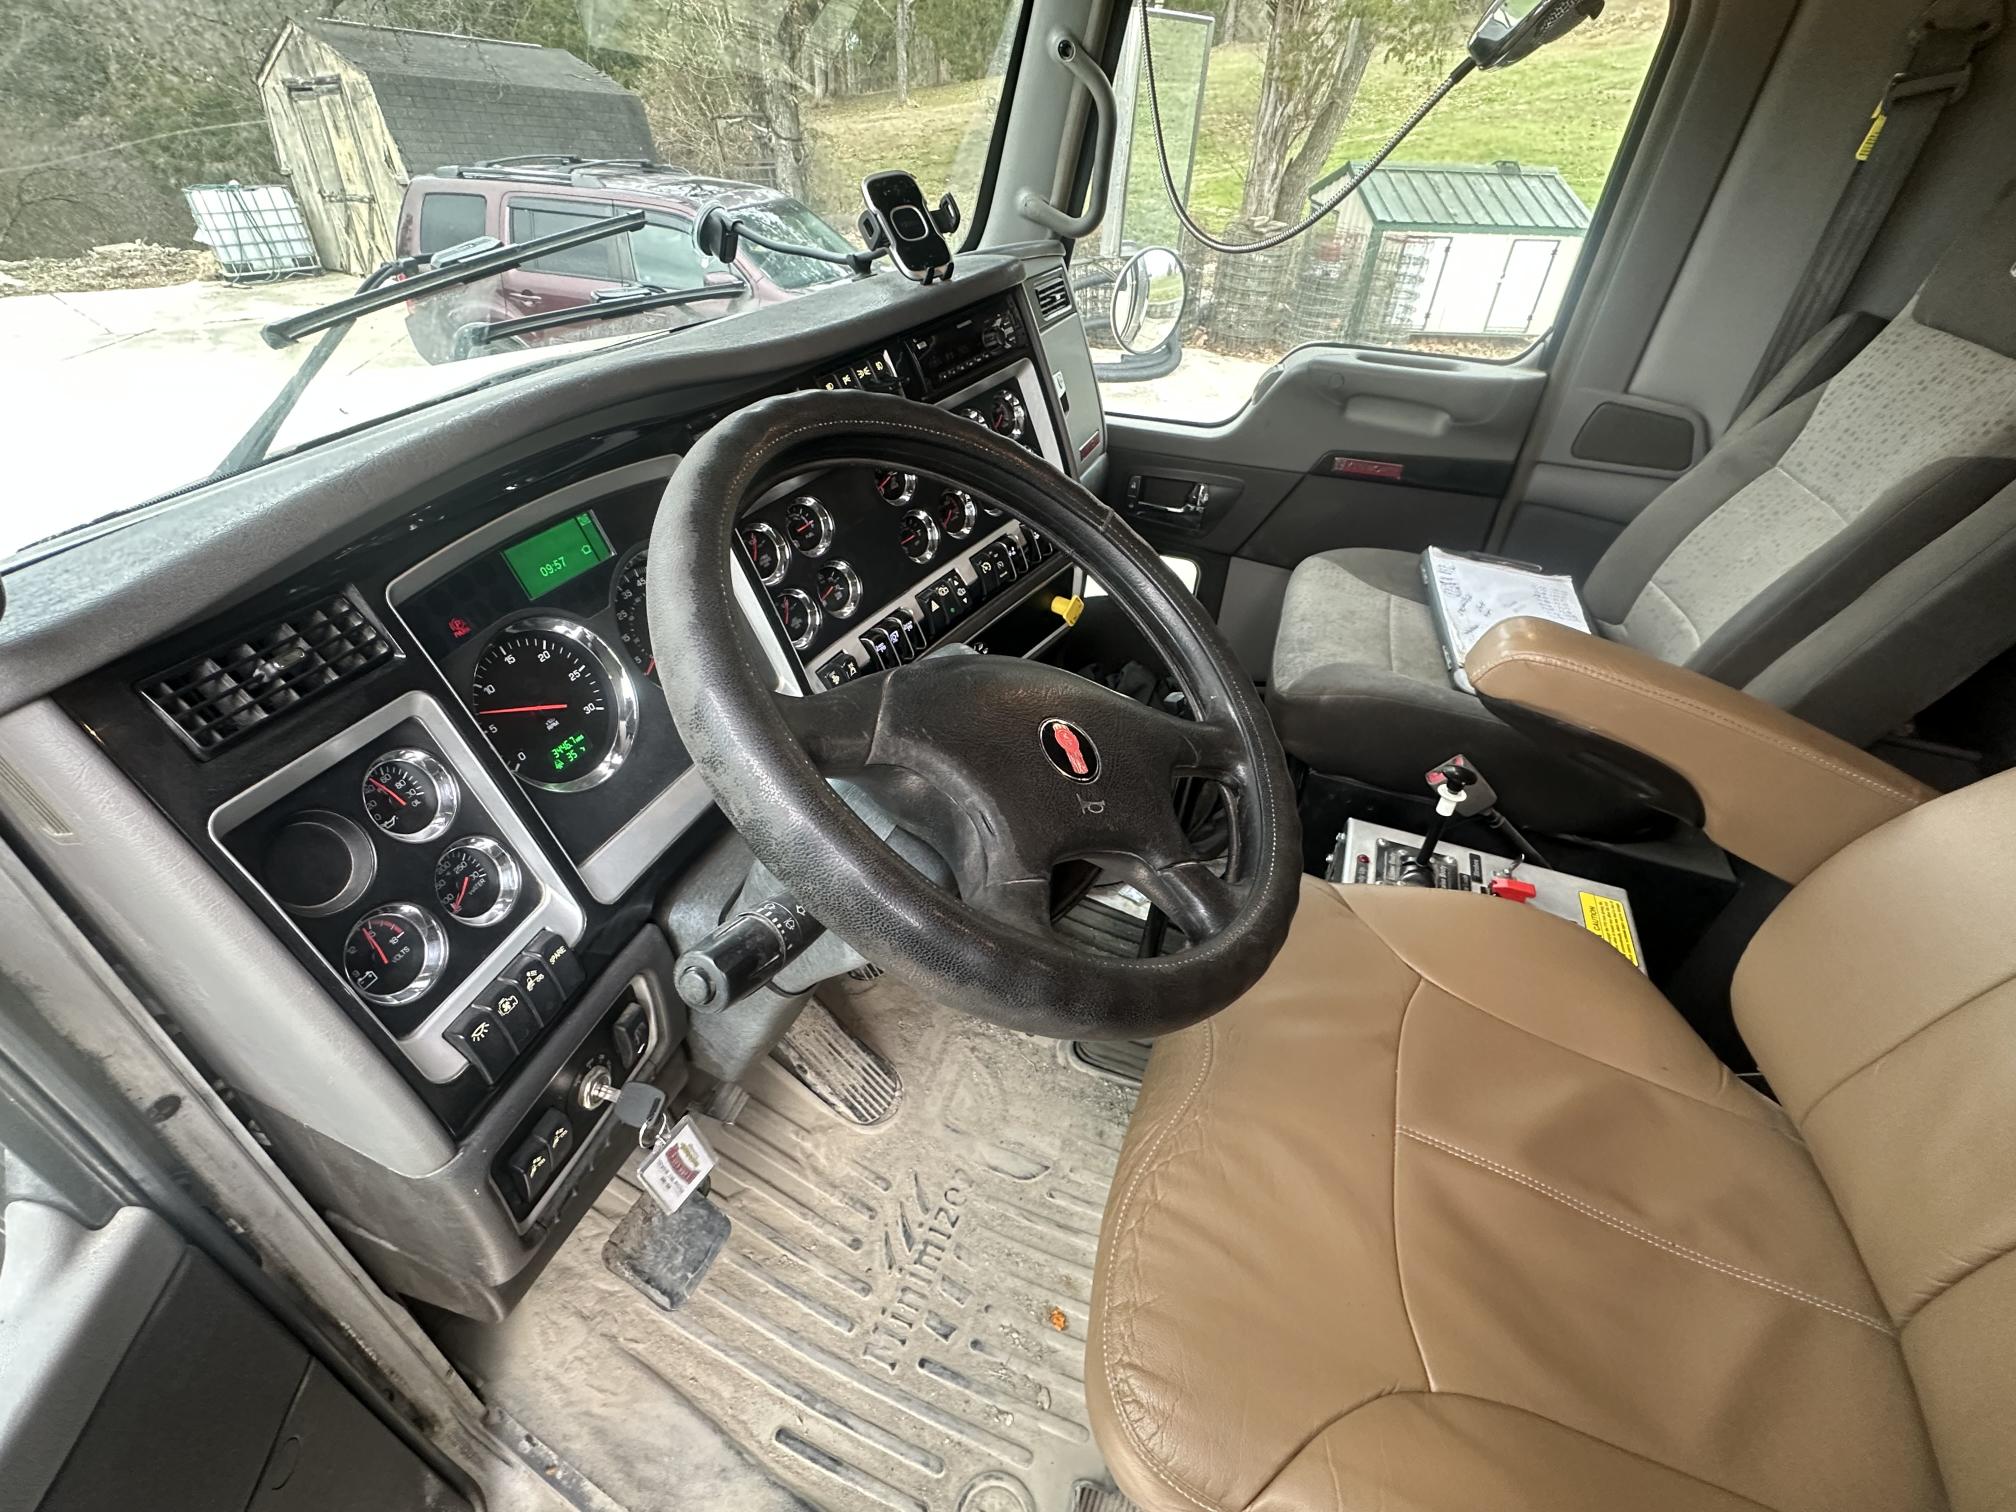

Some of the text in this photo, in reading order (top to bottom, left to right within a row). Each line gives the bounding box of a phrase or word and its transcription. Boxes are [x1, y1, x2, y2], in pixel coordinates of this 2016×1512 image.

[539, 556, 567, 578] 09:57
[504, 654, 516, 665] 15
[537, 651, 551, 662] 20
[568, 669, 581, 682] 25
[483, 684, 496, 695] 10
[583, 702, 596, 714] 30
[488, 724, 498, 734] 5
[517, 751, 527, 761] 0
[394, 779, 407, 790] 80
[453, 860, 469, 875] 250
[1588, 905, 1601, 932] CAUTION
[389, 936, 399, 945] 18
[549, 945, 567, 965] SPARE
[861, 1167, 974, 1375] Minimizer
